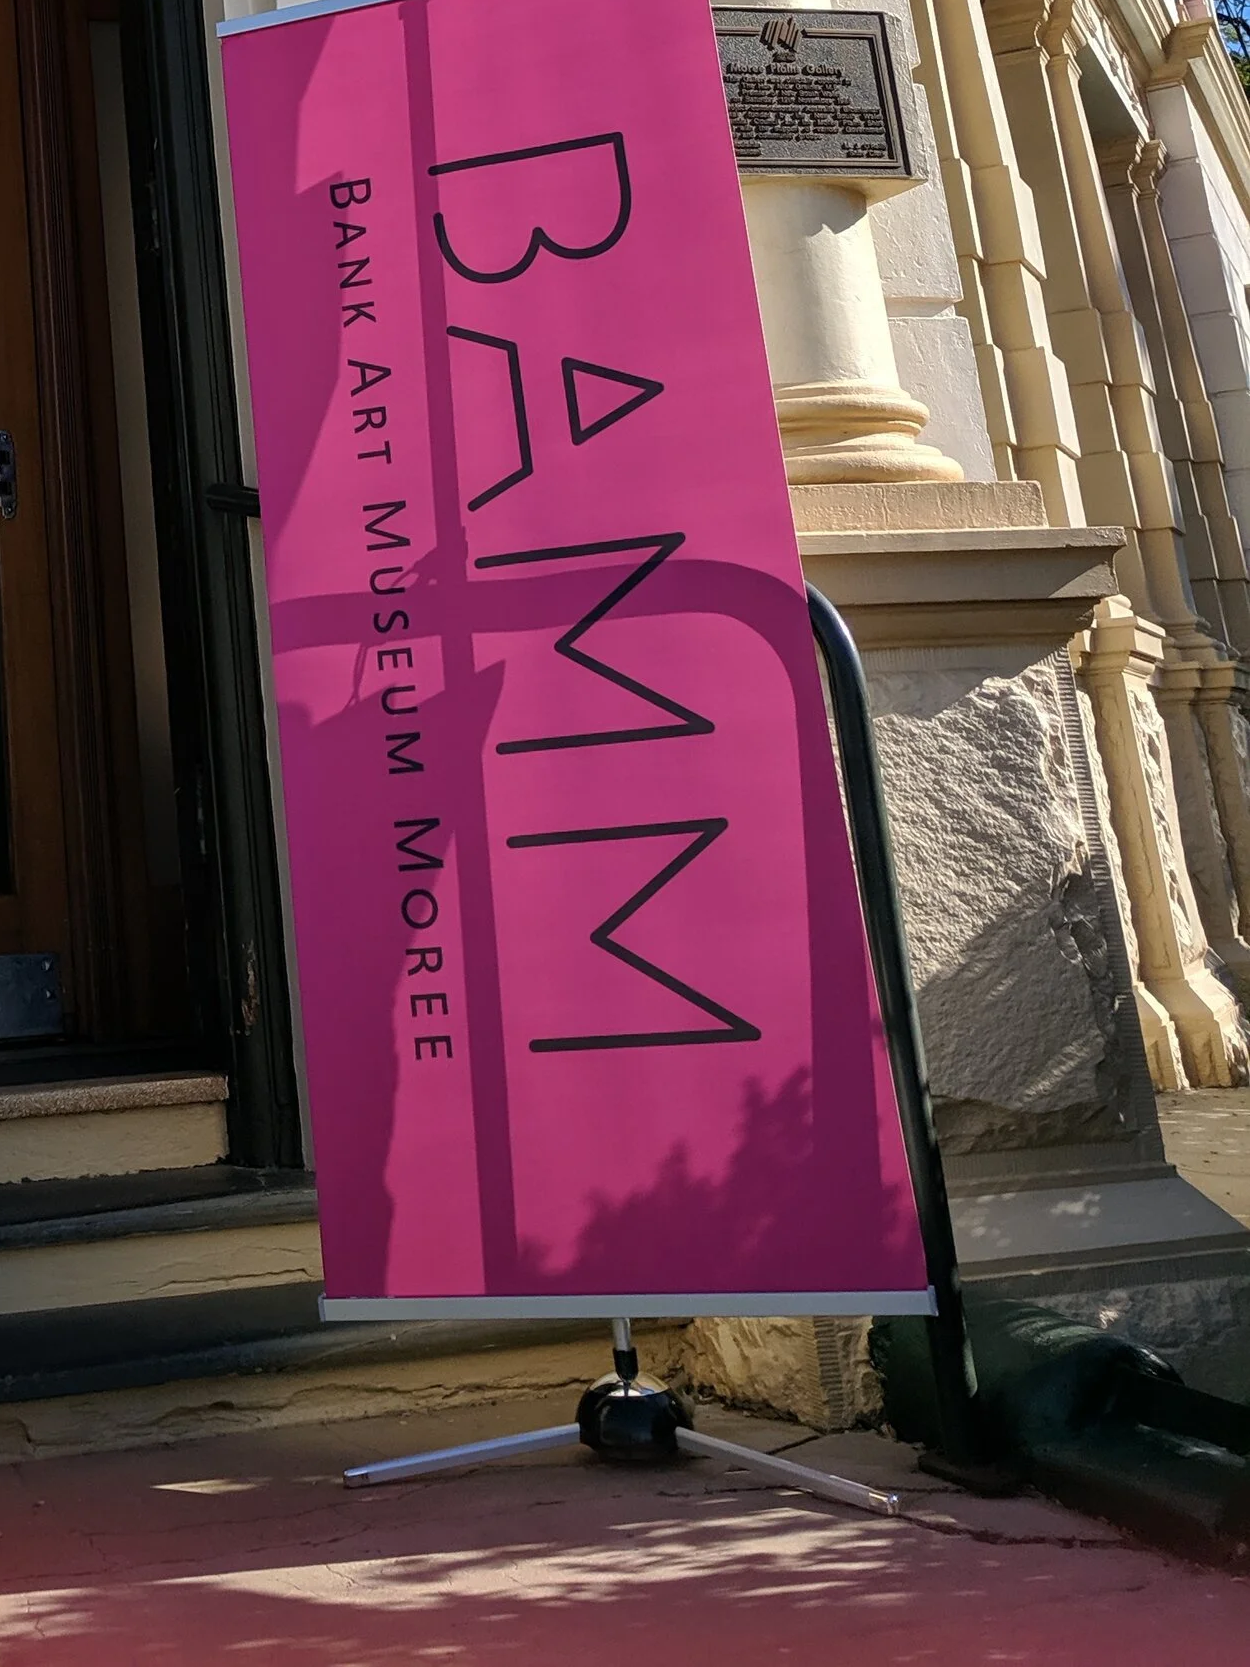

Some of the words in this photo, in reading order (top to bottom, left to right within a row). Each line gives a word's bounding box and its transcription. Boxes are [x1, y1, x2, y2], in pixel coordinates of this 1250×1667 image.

[805, 63, 845, 77] Gallery
[330, 177, 377, 328] BANK
[347, 358, 392, 465] ART
[362, 500, 424, 775] MUSEUM
[427, 130, 762, 1055] BAMM
[394, 817, 453, 1060] MOREE
